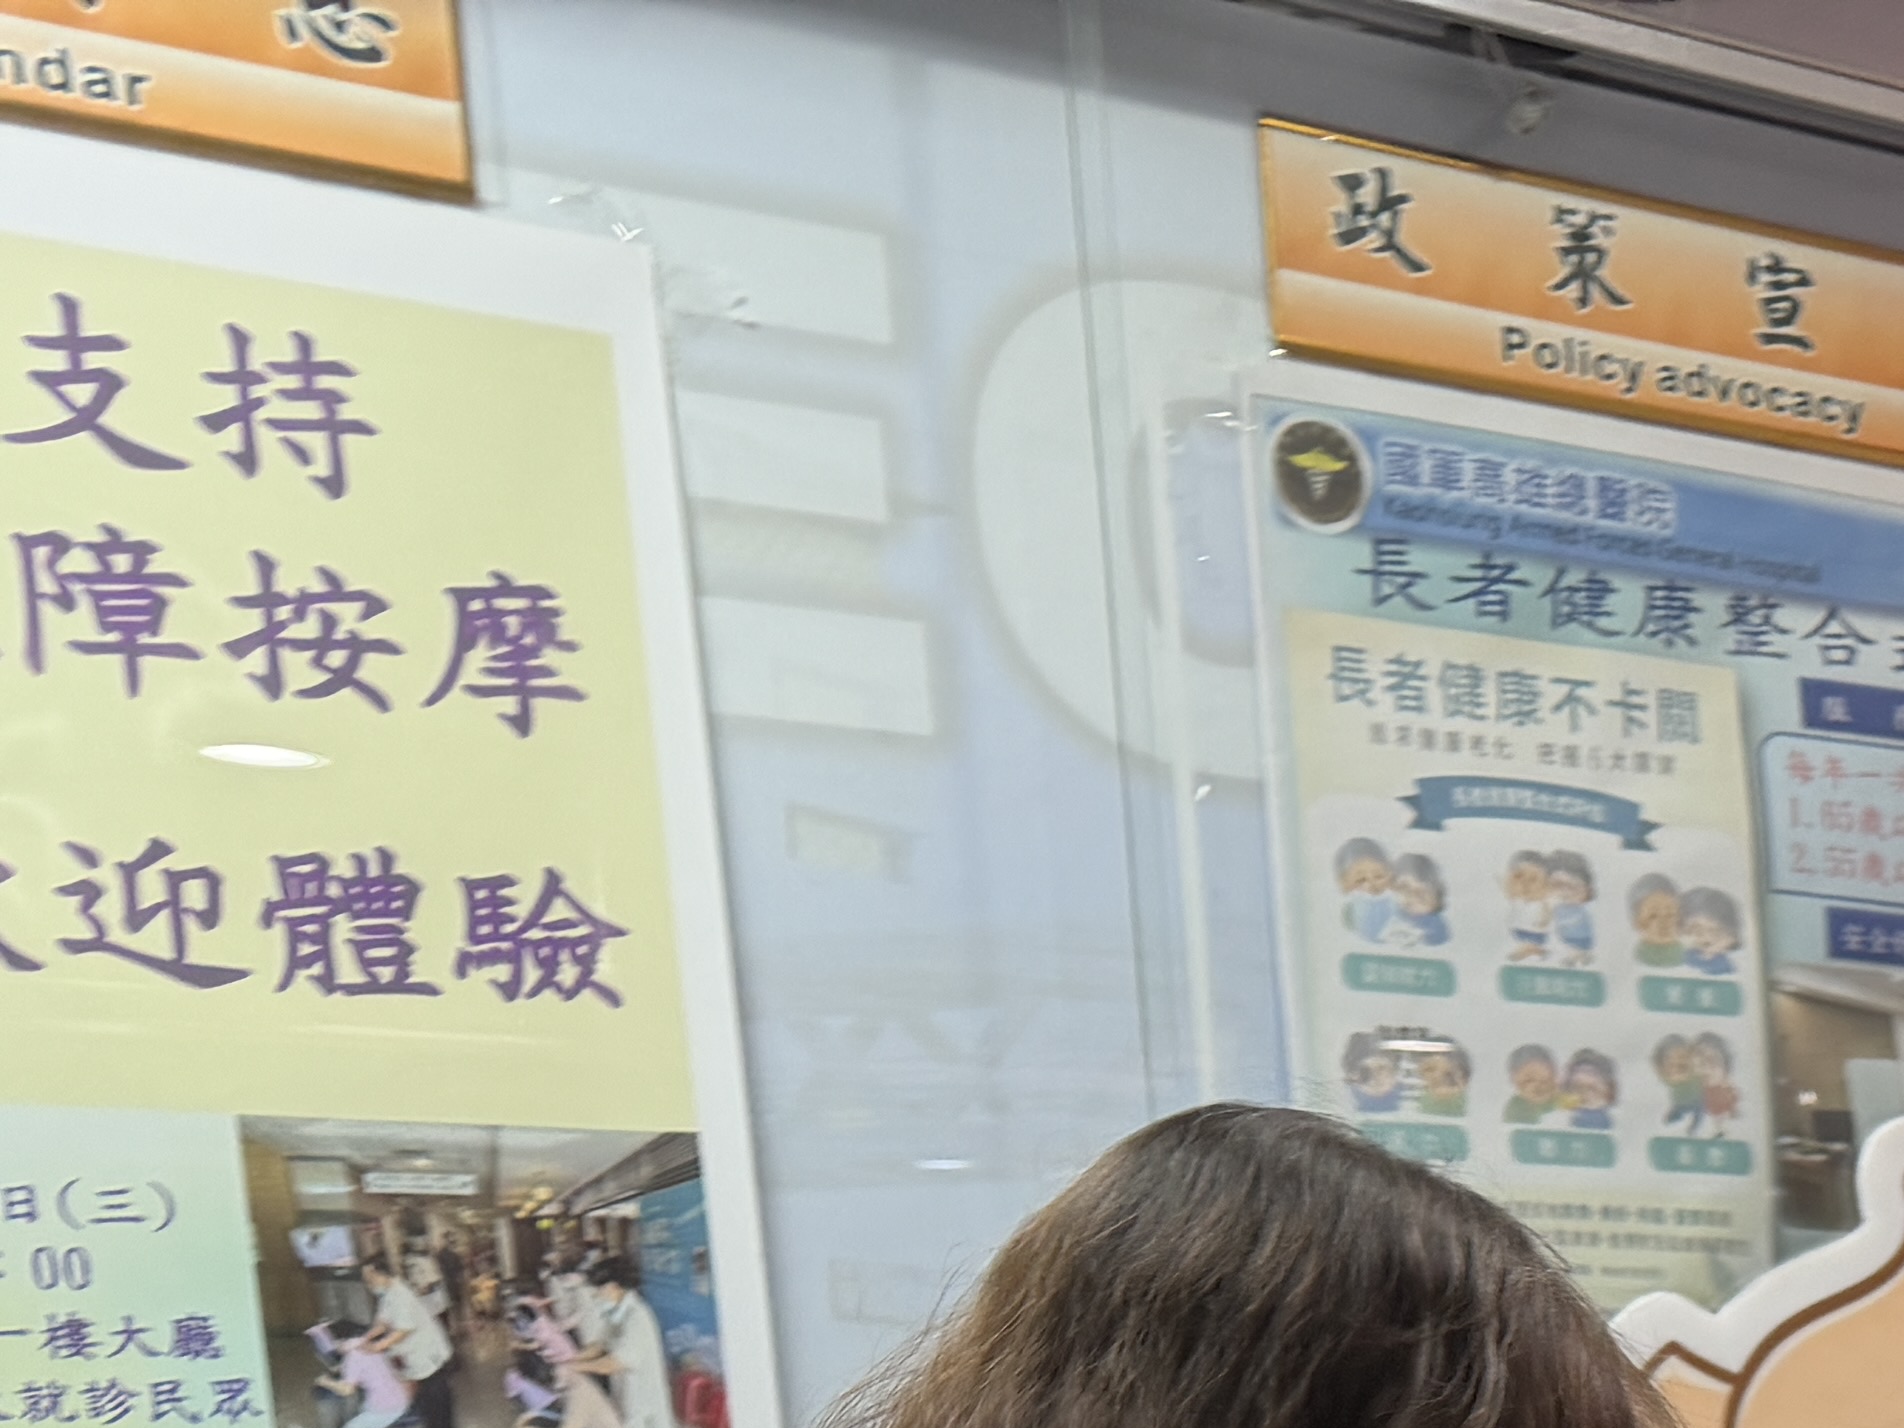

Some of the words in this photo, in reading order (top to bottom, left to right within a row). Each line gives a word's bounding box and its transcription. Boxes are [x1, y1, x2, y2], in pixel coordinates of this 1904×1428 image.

[2, 291, 383, 501] 支持
[1500, 323, 1650, 397] Policy
[1655, 355, 1867, 437] advocacy
[1327, 644, 1702, 745] 長者健康不卡關
